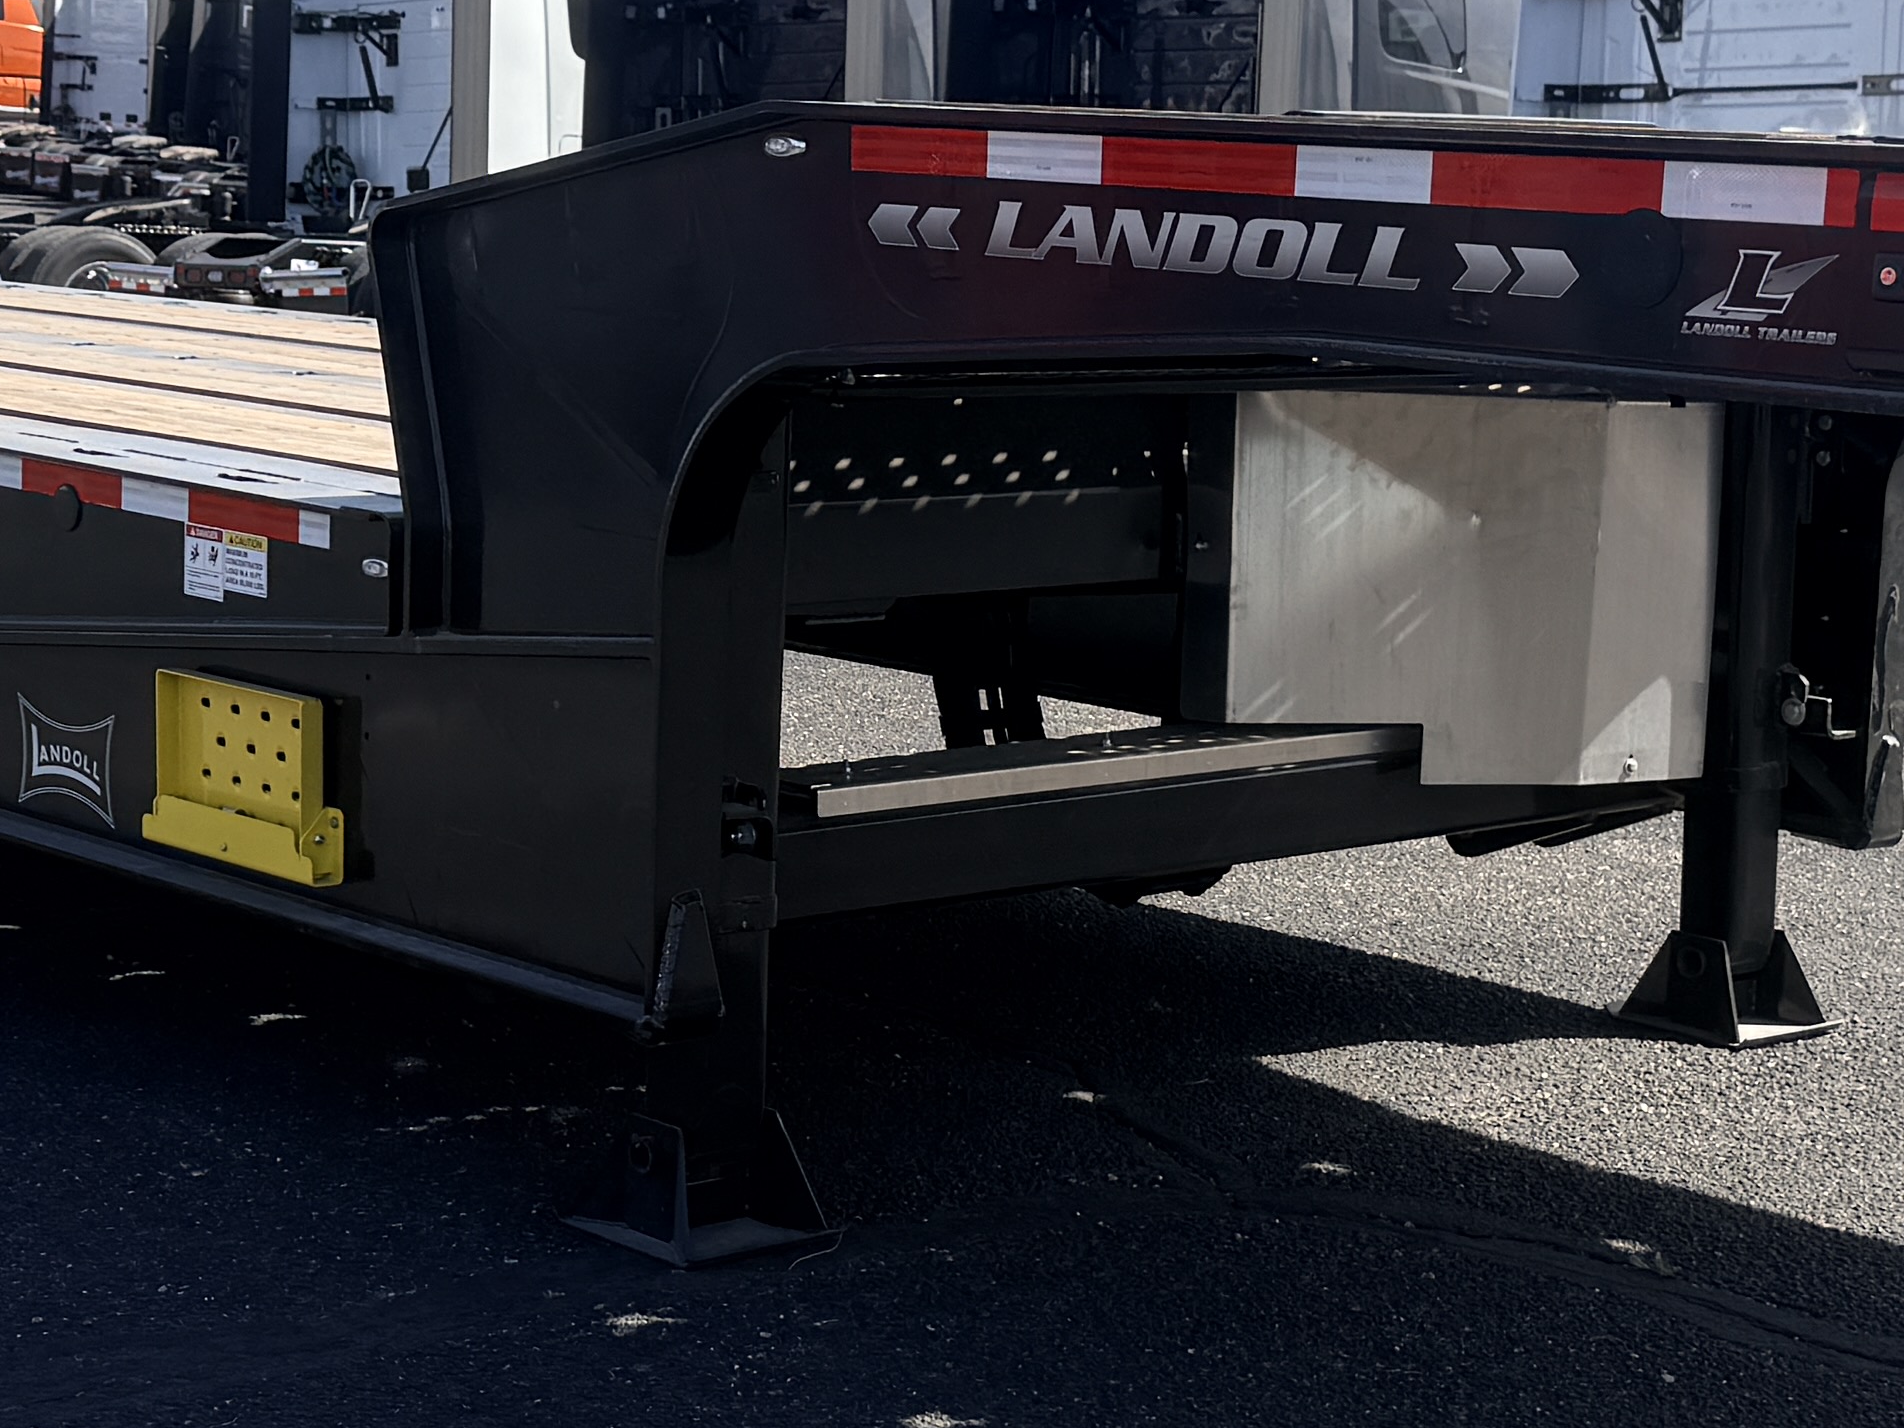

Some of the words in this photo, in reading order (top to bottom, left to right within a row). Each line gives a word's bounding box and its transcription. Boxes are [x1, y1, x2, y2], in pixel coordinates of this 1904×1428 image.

[984, 201, 1421, 291] LANDOLL
[1680, 321, 1752, 339] LANDOLL
[1757, 326, 1838, 346] TRAILERS
[234, 533, 263, 550] CAUTION
[31, 723, 101, 797] LANDOLL
